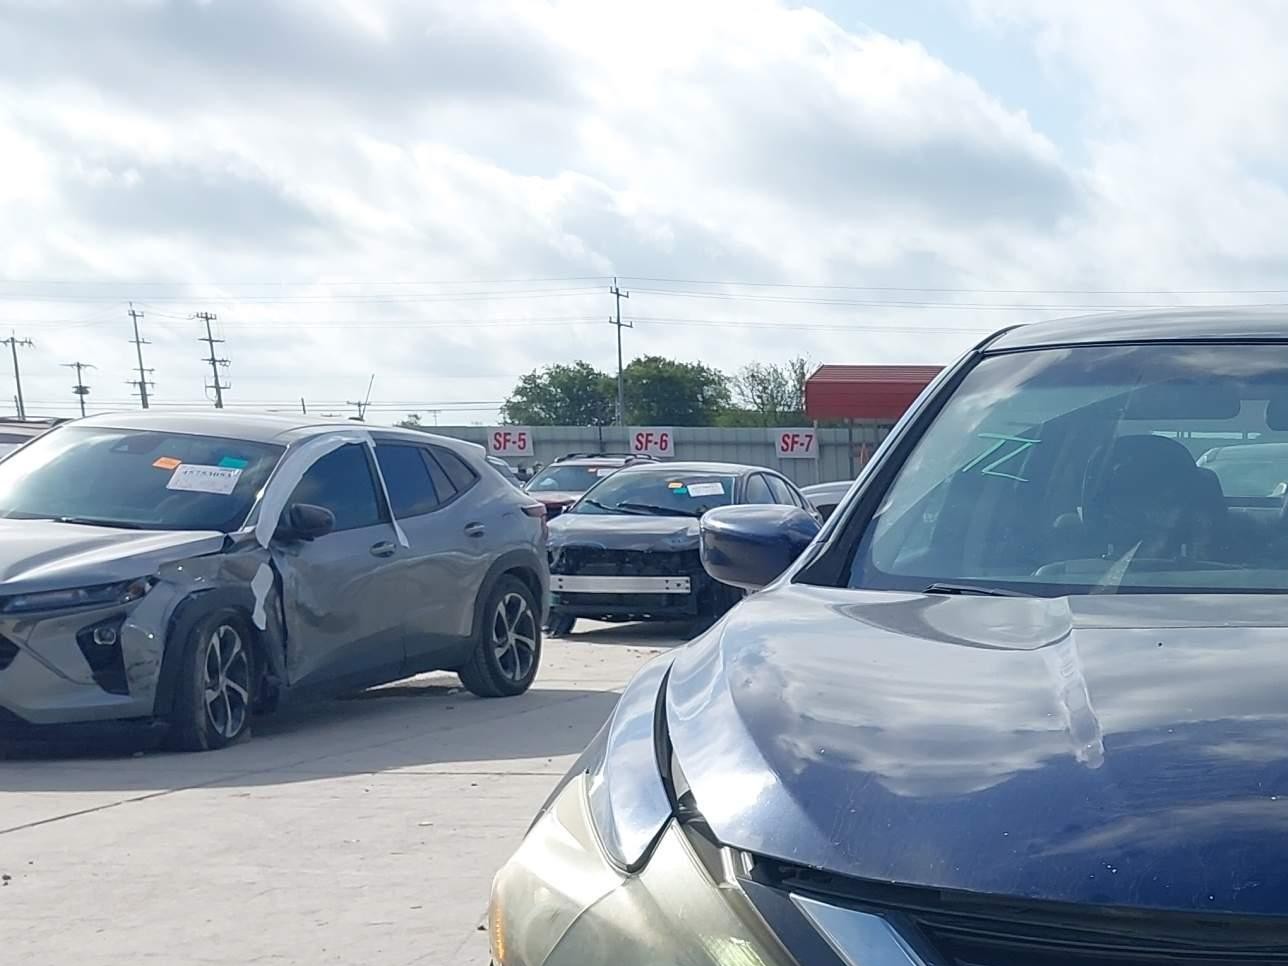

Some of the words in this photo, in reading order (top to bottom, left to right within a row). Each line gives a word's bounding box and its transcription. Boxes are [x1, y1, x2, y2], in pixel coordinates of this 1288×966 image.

[493, 431, 526, 450] SF-5
[635, 432, 668, 451] SF-6
[781, 433, 813, 452] SF-7
